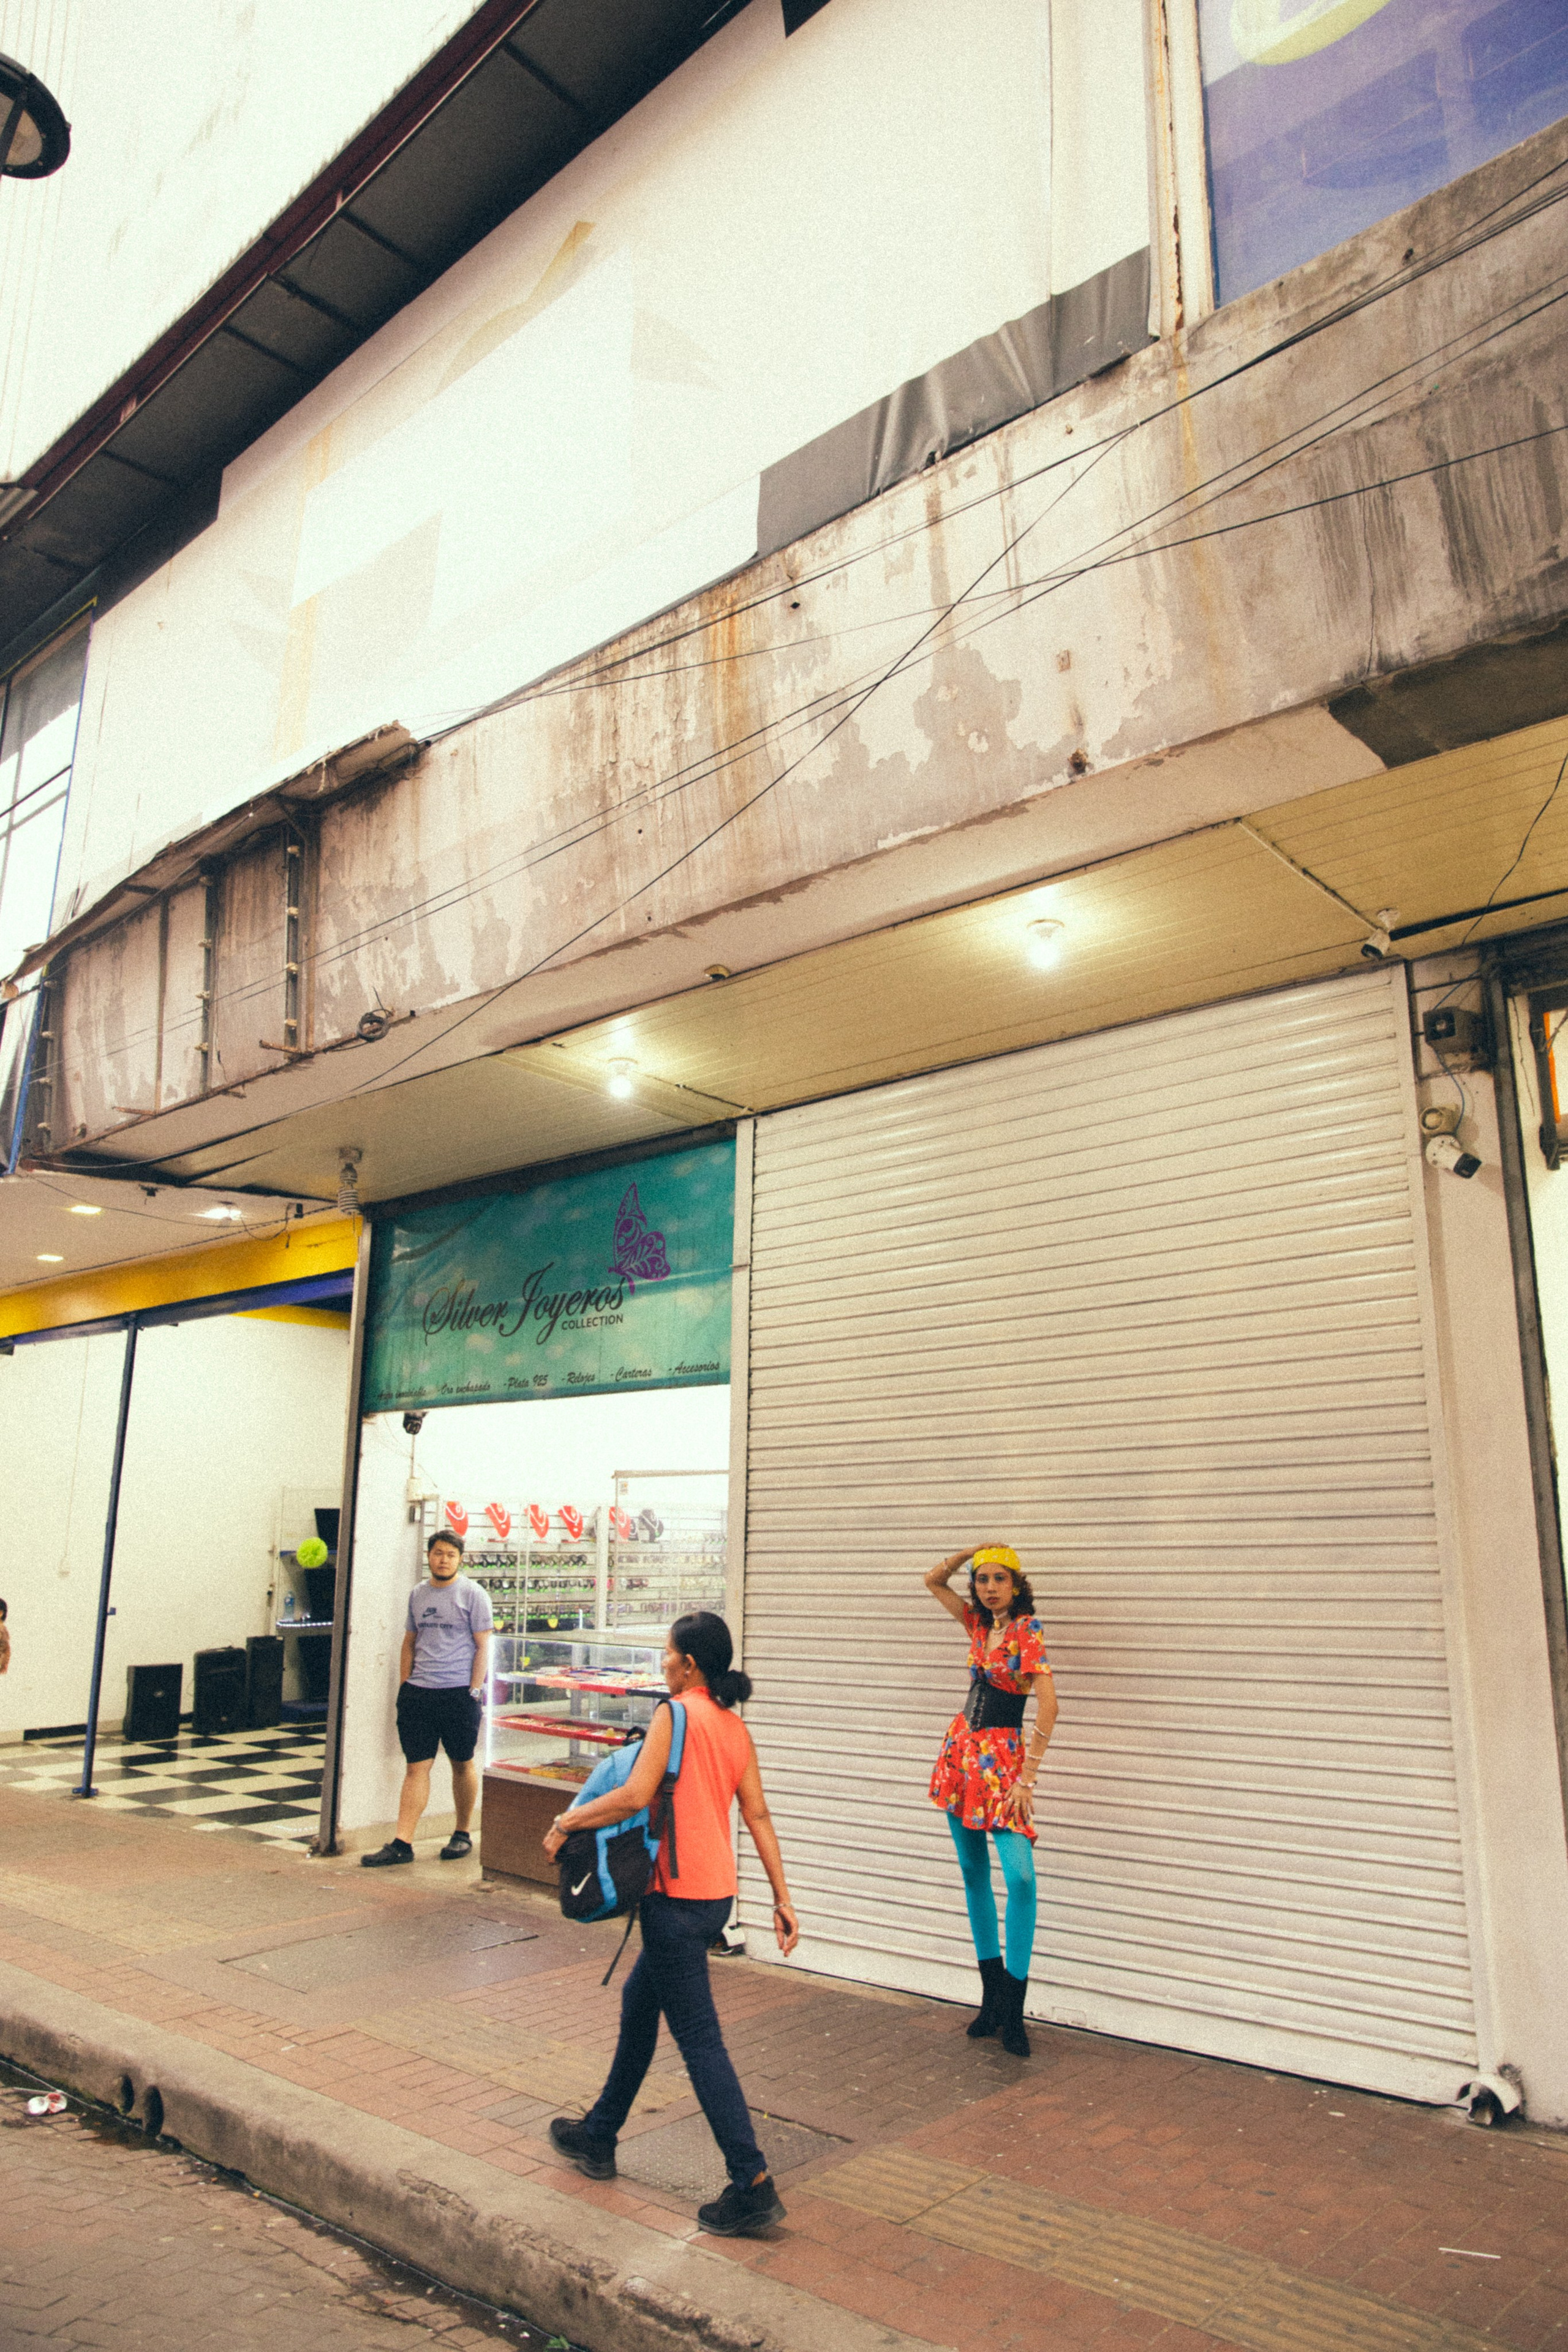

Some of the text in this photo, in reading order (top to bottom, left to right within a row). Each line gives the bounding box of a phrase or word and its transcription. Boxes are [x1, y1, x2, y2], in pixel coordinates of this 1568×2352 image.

[423, 1262, 625, 1346] Silver Joyeros
[562, 1314, 624, 1330] COLLECTION
[533, 1374, 548, 1386] 925
